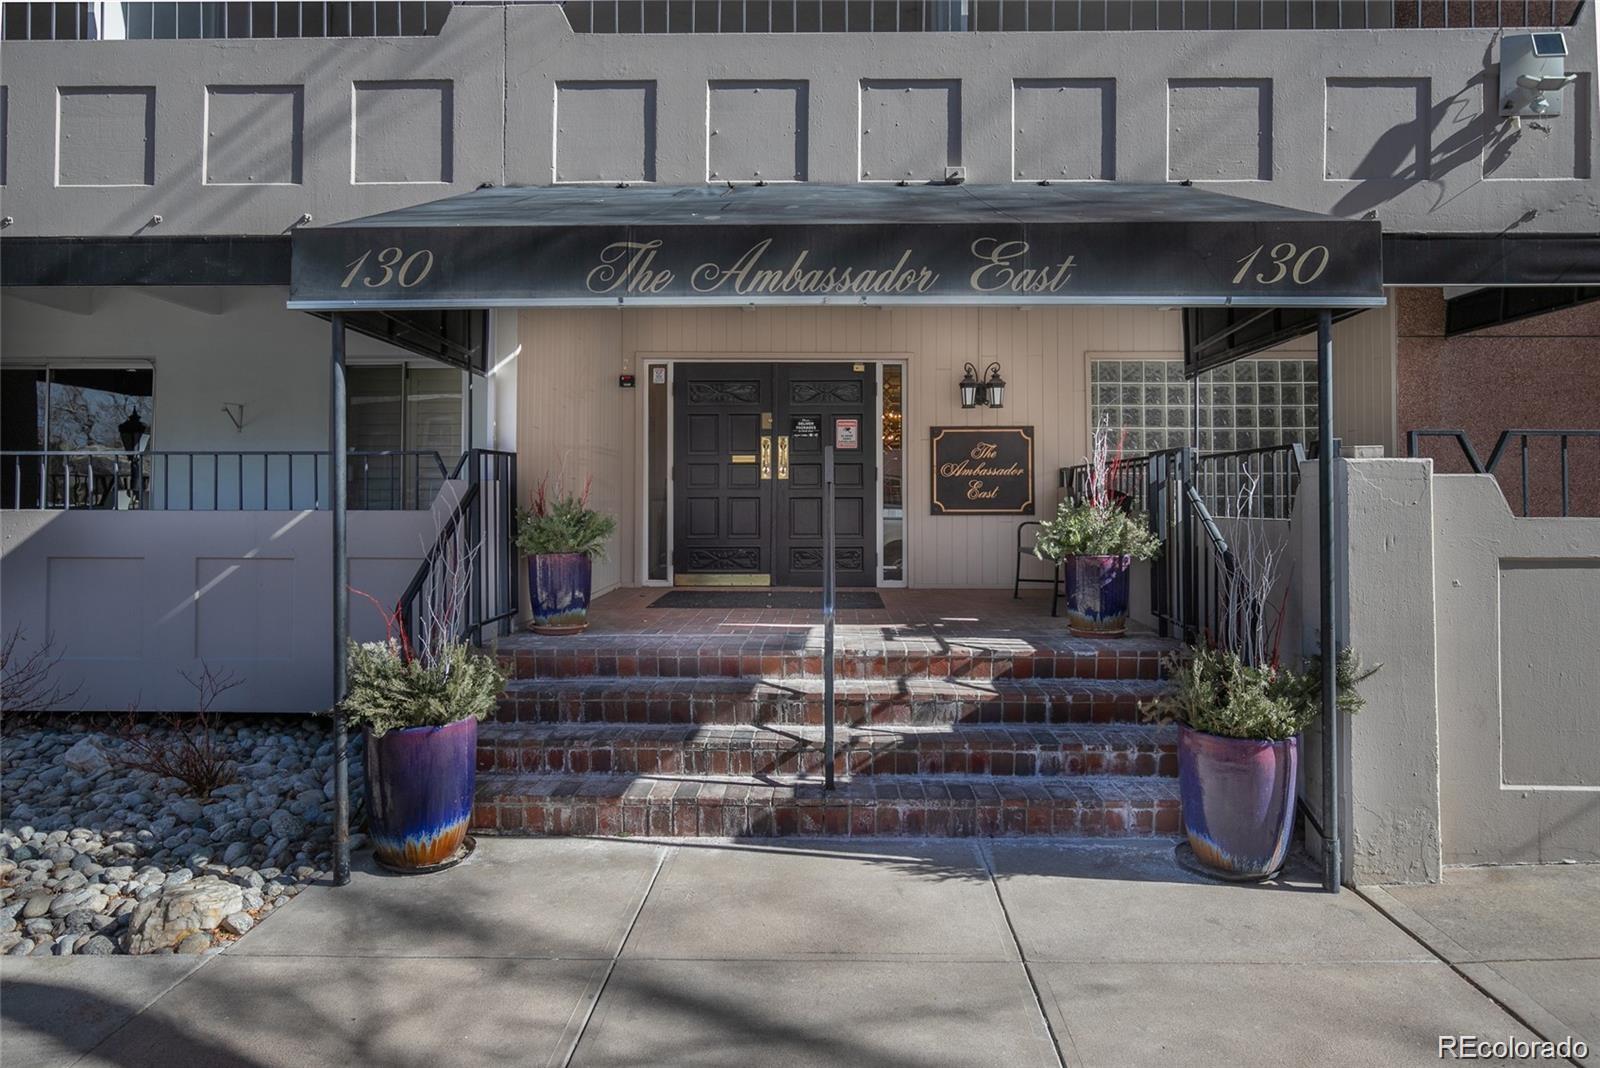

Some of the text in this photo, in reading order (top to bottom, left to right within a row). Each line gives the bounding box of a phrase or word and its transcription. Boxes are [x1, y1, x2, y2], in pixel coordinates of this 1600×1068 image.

[340, 246, 434, 289] 130
[586, 236, 1077, 295] The Ambassador East
[1231, 242, 1330, 285] 130
[970, 441, 998, 460] The
[940, 459, 1025, 478] Ambassador
[967, 479, 1000, 501] East
